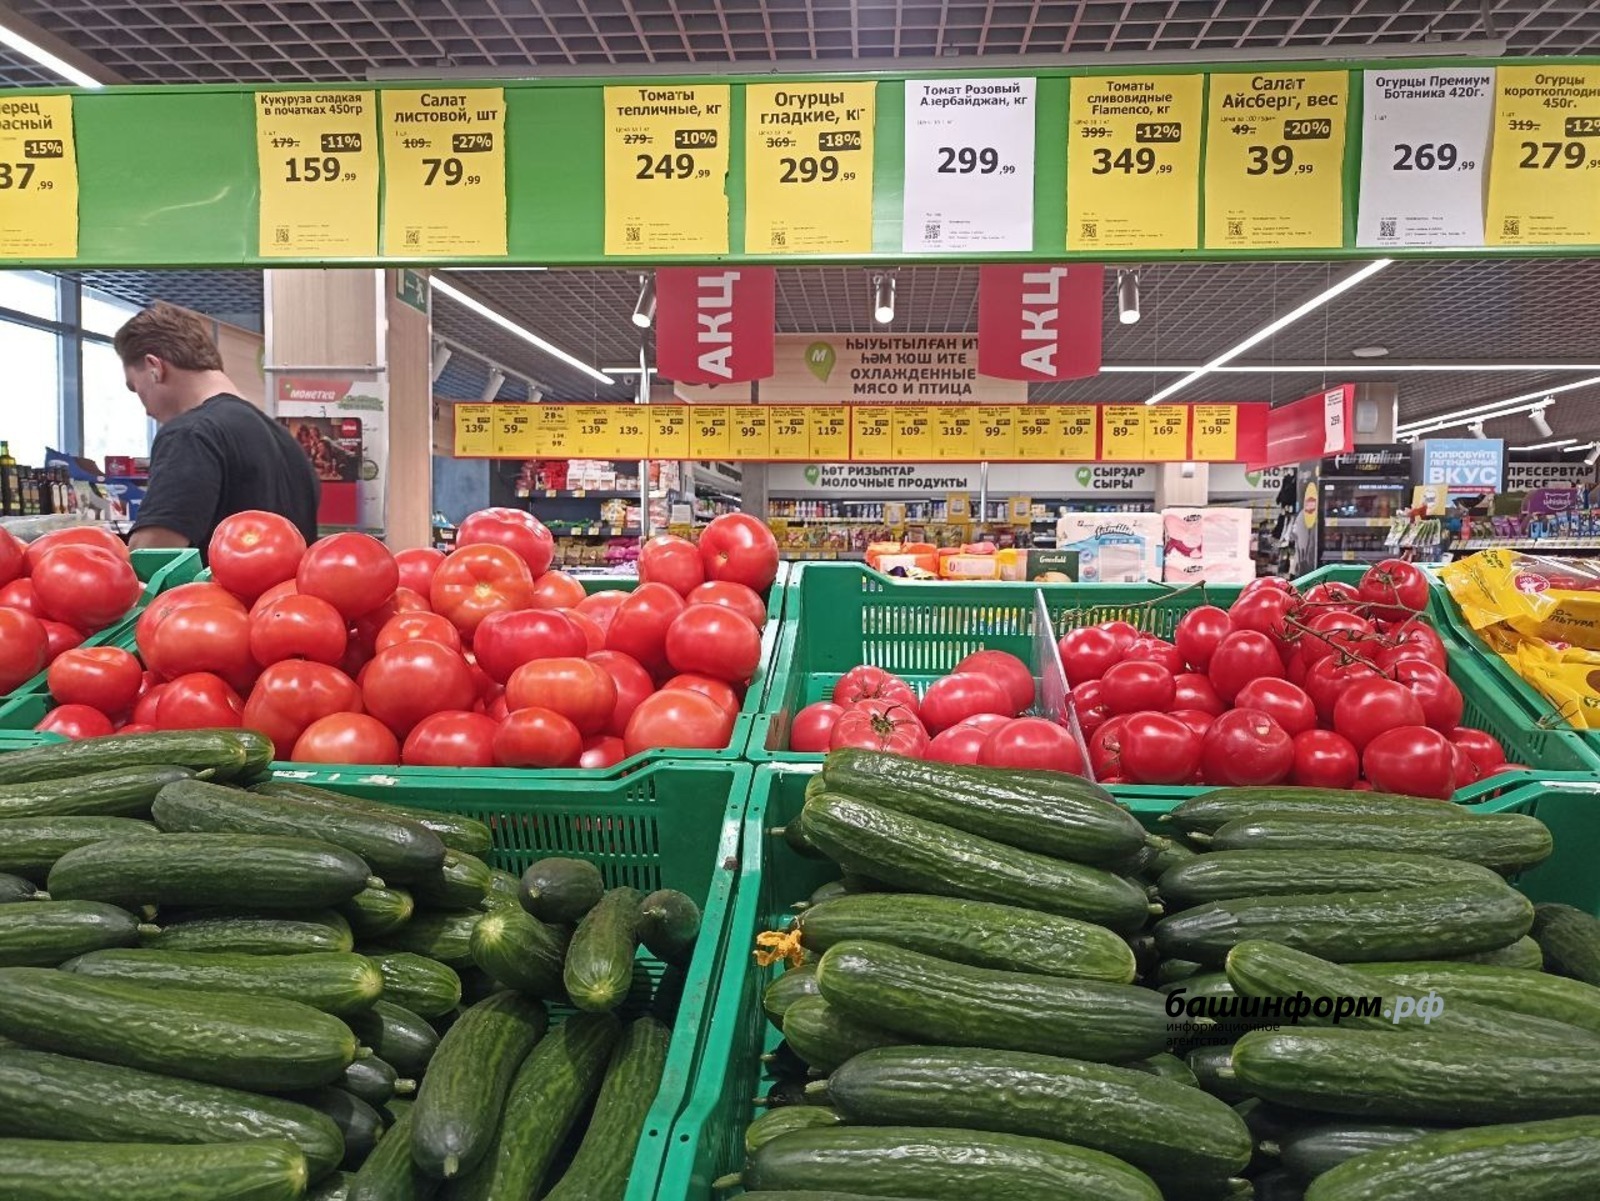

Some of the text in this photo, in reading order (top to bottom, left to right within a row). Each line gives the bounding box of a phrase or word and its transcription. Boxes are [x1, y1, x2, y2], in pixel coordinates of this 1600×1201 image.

[1107, 81, 1154, 92] Томаты
[1252, 76, 1306, 91] Салат
[1375, 76, 1490, 90] Огурцы Премиум
[1535, 74, 1585, 87] Огурцы
[638, 89, 695, 102] Томаты
[924, 83, 1020, 96] Томат Розовый
[1384, 87, 1485, 99] Ботаника 420г.
[261, 93, 362, 108] Кукуруза сладкая
[421, 93, 467, 107] Салат
[775, 92, 844, 109] Огурцы
[920, 95, 1028, 107] Азербайджан, кг
[1087, 93, 1173, 104] сливовидные
[1307, 94, 1338, 107] вес
[1543, 98, 1577, 109] 450г.
[264, 104, 363, 117] в початках 450гр
[394, 109, 498, 124] листовой, шт
[617, 104, 722, 117] тепличные, кг
[761, 108, 840, 126] гладкие,
[1092, 104, 1170, 117] Flamenco, кг
[1137, 125, 1180, 138] -12%
[1285, 122, 1330, 135] -20%
[322, 137, 361, 148] -11%
[453, 136, 491, 148] -27%
[676, 132, 716, 145] -10%
[819, 134, 861, 147] -18%
[25, 142, 62, 155] -15%
[937, 353, 966, 364] ИТЕ
[850, 368, 976, 382] ОХЛАЖДЕННЫЕ
[853, 383, 972, 396] МЯСО И ПТИЦА
[503, 424, 518, 434] 59
[581, 425, 600, 434] 139
[619, 426, 639, 435] 139
[659, 425, 673, 435] 39
[701, 426, 716, 436] 99
[741, 427, 755, 436] 99
[862, 426, 882, 436] 229
[985, 427, 1000, 436] 99
[1022, 426, 1042, 435] 599
[1153, 426, 1173, 435] 169
[1202, 426, 1222, 435] 199
[1430, 467, 1496, 484] ВКУС
[821, 477, 967, 489] МОЛОЧНЫЕ ПРОДУКТЫ
[1093, 479, 1133, 489] СЫРЫ
